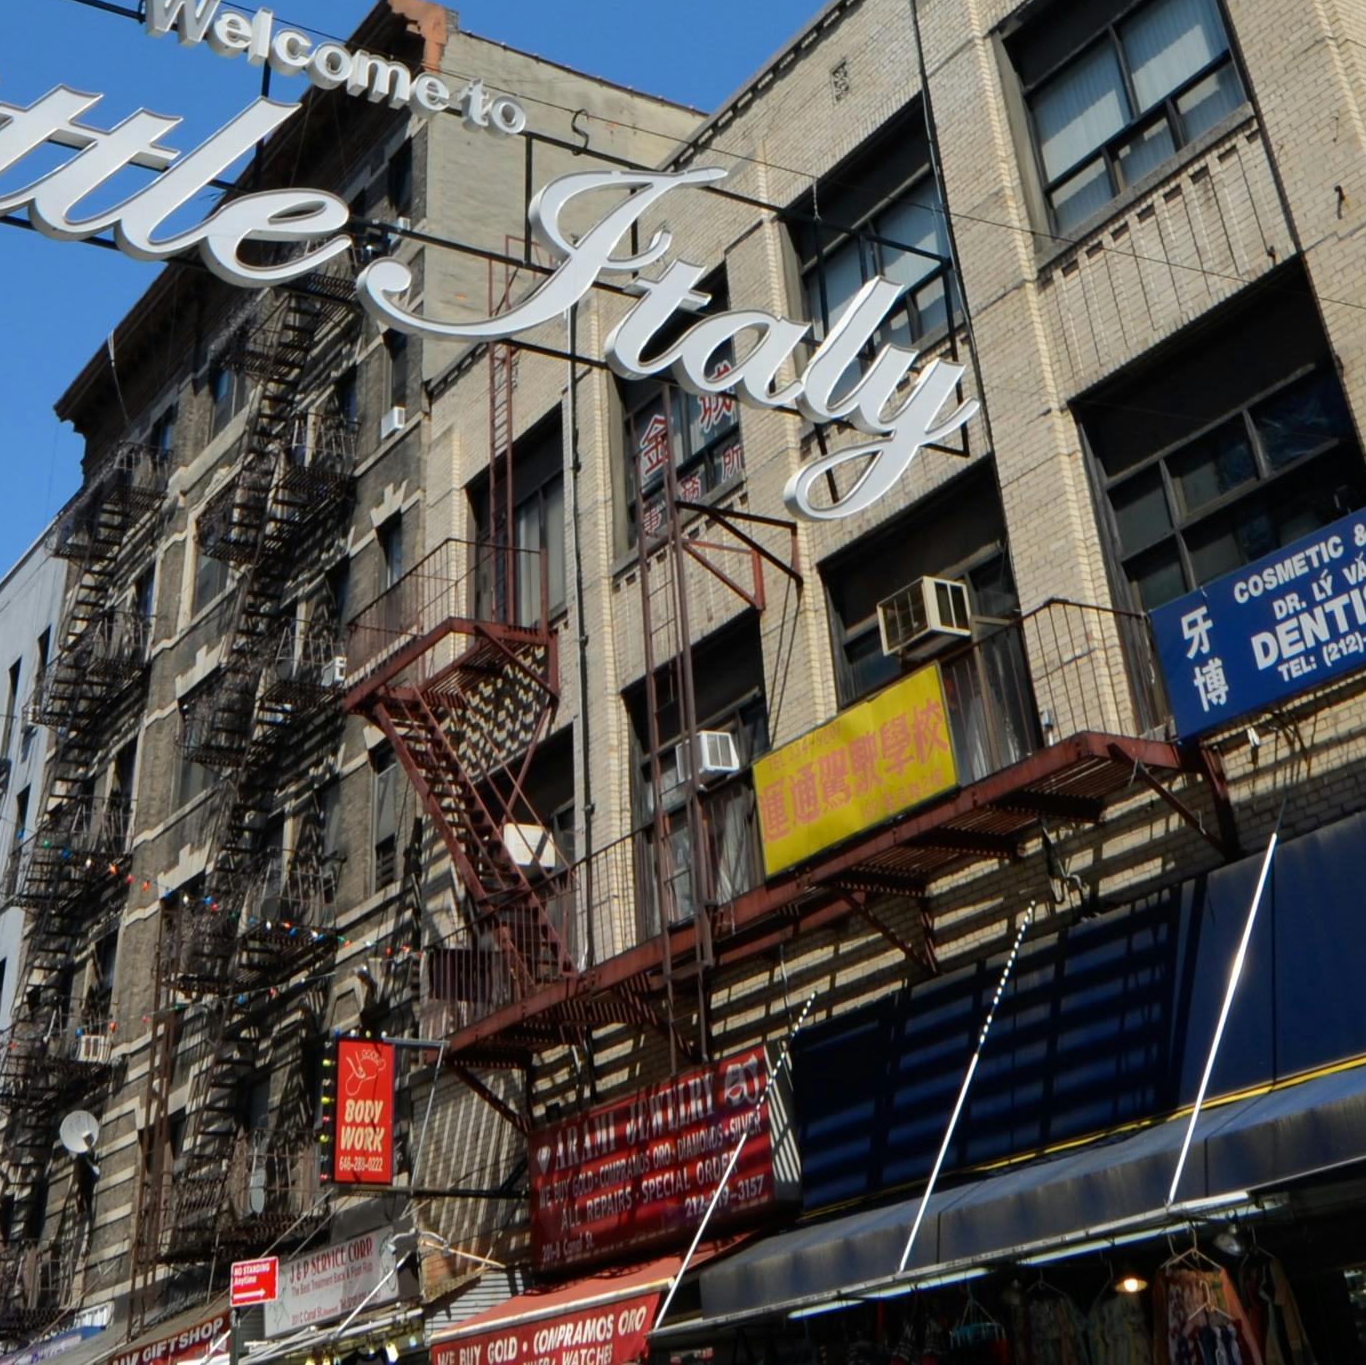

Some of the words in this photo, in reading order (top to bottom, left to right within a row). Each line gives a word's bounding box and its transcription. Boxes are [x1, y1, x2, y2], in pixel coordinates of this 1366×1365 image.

[462, 77, 526, 138] to
[356, 166, 979, 521] Italy
[1233, 535, 1344, 604] COSMETIC
[1272, 593, 1307, 620] DR.
[1278, 657, 1317, 682] TEL:
[340, 1125, 385, 1153] WORK
[344, 1098, 383, 1124] BODY
[555, 1111, 616, 1171] ARAMI
[626, 1072, 715, 1146] JEWELRY
[553, 1180, 570, 1203] BUY
[653, 1141, 671, 1168] ORO
[677, 1121, 723, 1164] DIAMONDS
[560, 1203, 581, 1232] ALL
[586, 1186, 633, 1222] REPAIRS
[641, 1167, 691, 1203] SPECIAL
[234, 1266, 243, 1276] NO
[243, 1263, 271, 1275] STANDING
[311, 1246, 346, 1276] SERVICE
[459, 1344, 481, 1365] BUY
[488, 1336, 517, 1365] GOLD
[618, 1306, 647, 1335] ORO
